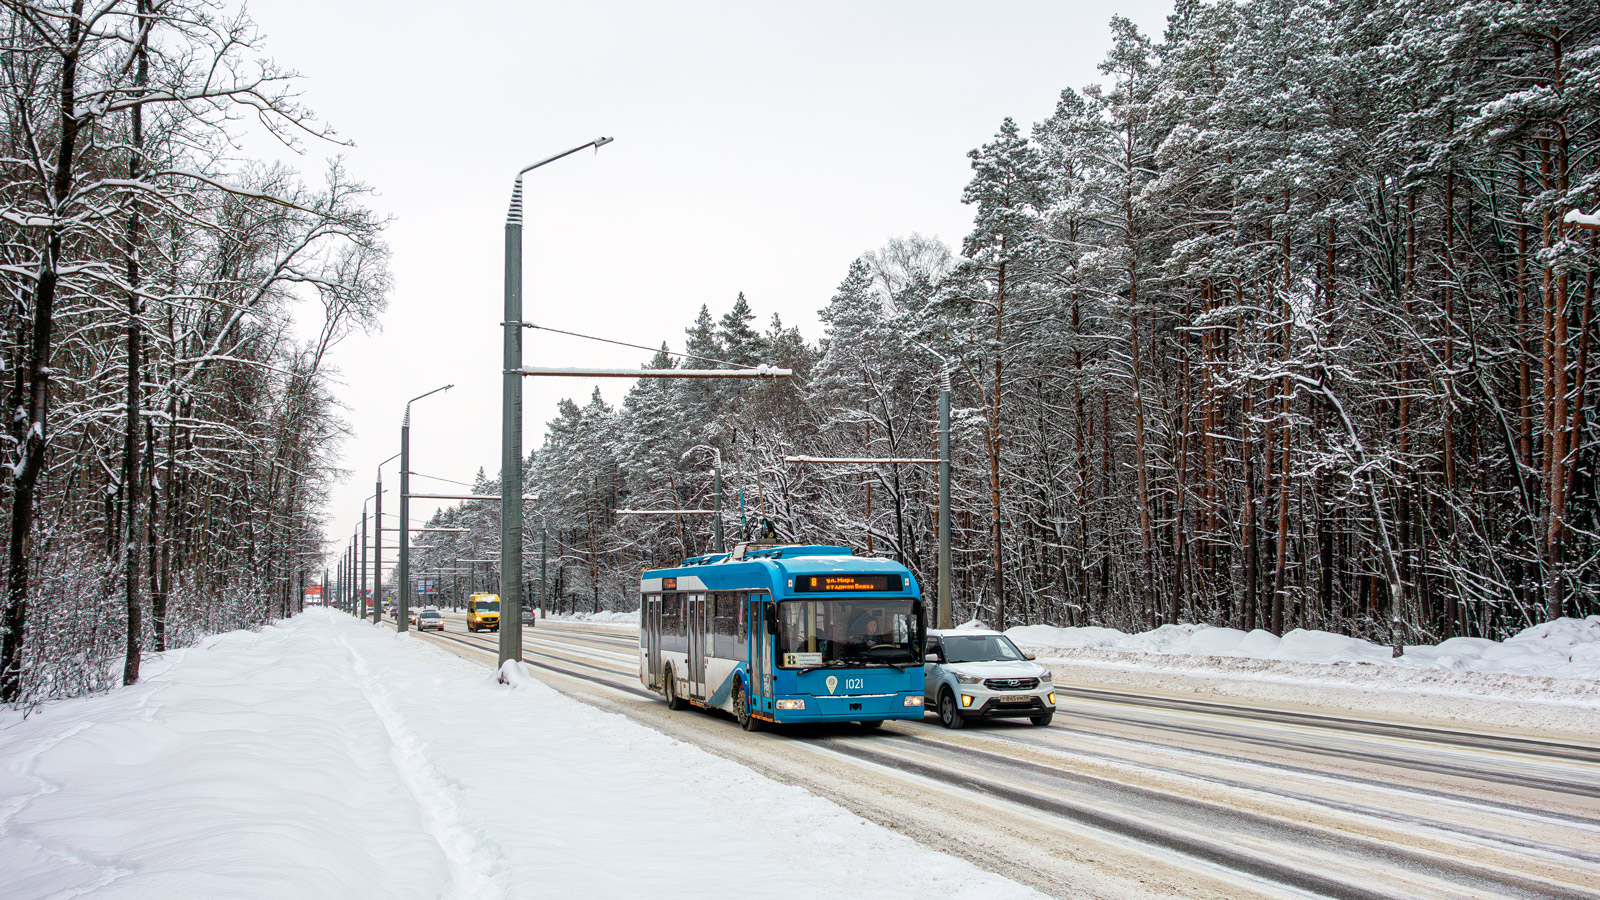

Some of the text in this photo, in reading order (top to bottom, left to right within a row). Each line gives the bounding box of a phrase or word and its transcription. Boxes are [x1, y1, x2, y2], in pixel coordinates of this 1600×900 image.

[811, 577, 817, 587] 8
[787, 655, 796, 665] 8
[845, 679, 863, 689] 1021
